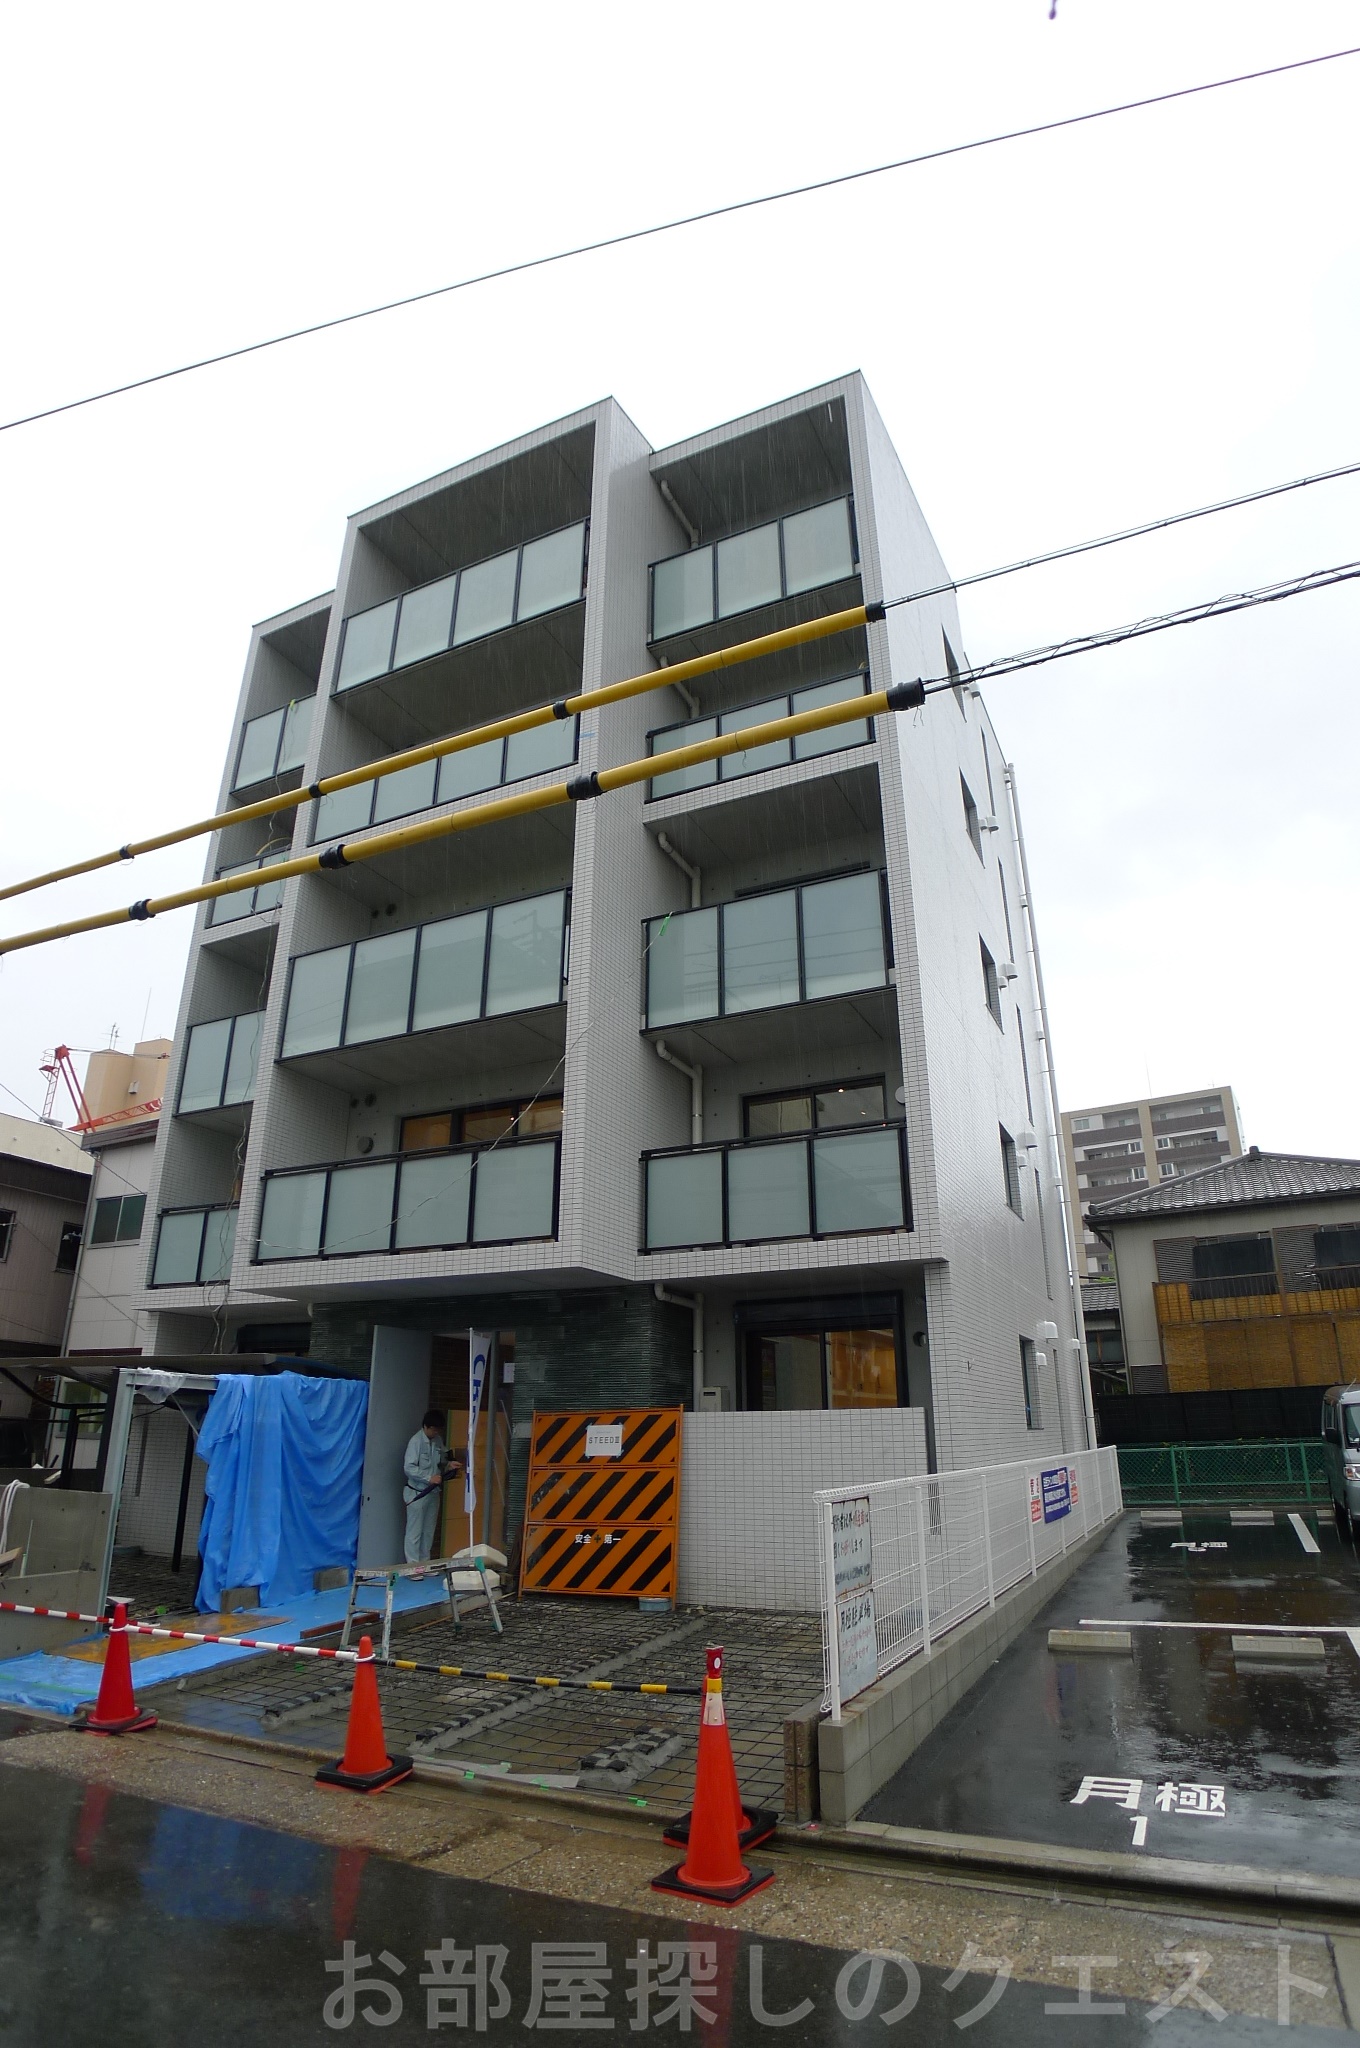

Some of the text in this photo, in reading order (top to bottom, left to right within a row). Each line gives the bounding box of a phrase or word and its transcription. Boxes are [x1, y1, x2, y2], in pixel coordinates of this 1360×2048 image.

[575, 1533, 622, 1544] 安全 第一
[1070, 1776, 1226, 1817] 月極
[1129, 1815, 1148, 1846] 1
